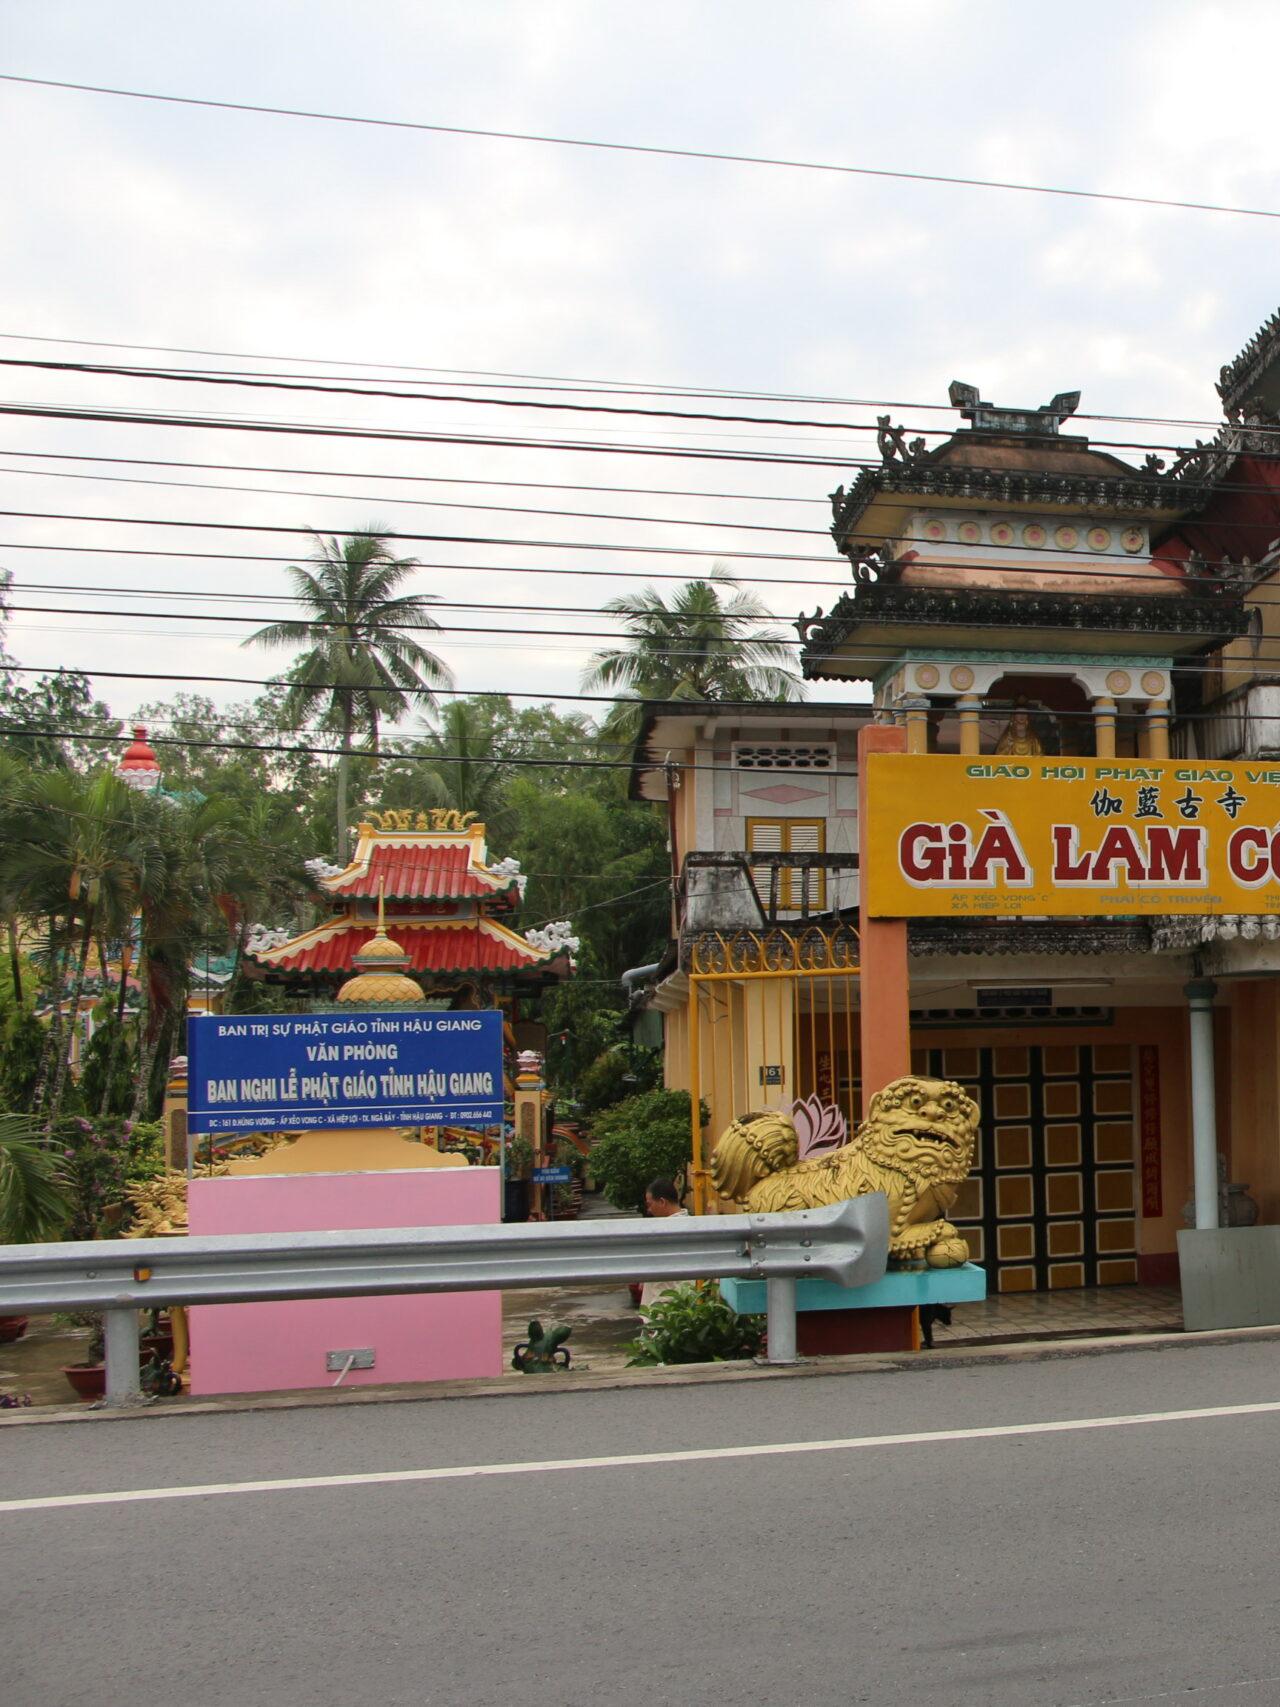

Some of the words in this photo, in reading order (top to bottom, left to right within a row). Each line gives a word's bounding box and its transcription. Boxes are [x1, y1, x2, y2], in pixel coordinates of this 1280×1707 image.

[1050, 824, 1208, 888] LAM
[218, 1025, 247, 1036] BAN
[250, 1025, 269, 1037] TRỊ
[273, 1022, 291, 1037] SỰ
[294, 1021, 328, 1036] PHẬT
[331, 1020, 367, 1034] GIÁO
[371, 1018, 400, 1033] TỈNH
[403, 1019, 432, 1034] HẬU
[436, 1020, 482, 1031] GIANG
[306, 1043, 339, 1061] VĂN
[343, 1041, 398, 1060] PHÒNG
[207, 1080, 238, 1103] BAN
[240, 1079, 277, 1102] NGHI
[280, 1067, 298, 1100] LỄ
[301, 1072, 339, 1106] PHẬT
[343, 1070, 377, 1099] GIÁO
[380, 1067, 414, 1098] TỈNH
[417, 1069, 446, 1103] HẬU
[450, 1072, 493, 1096] GIANG
